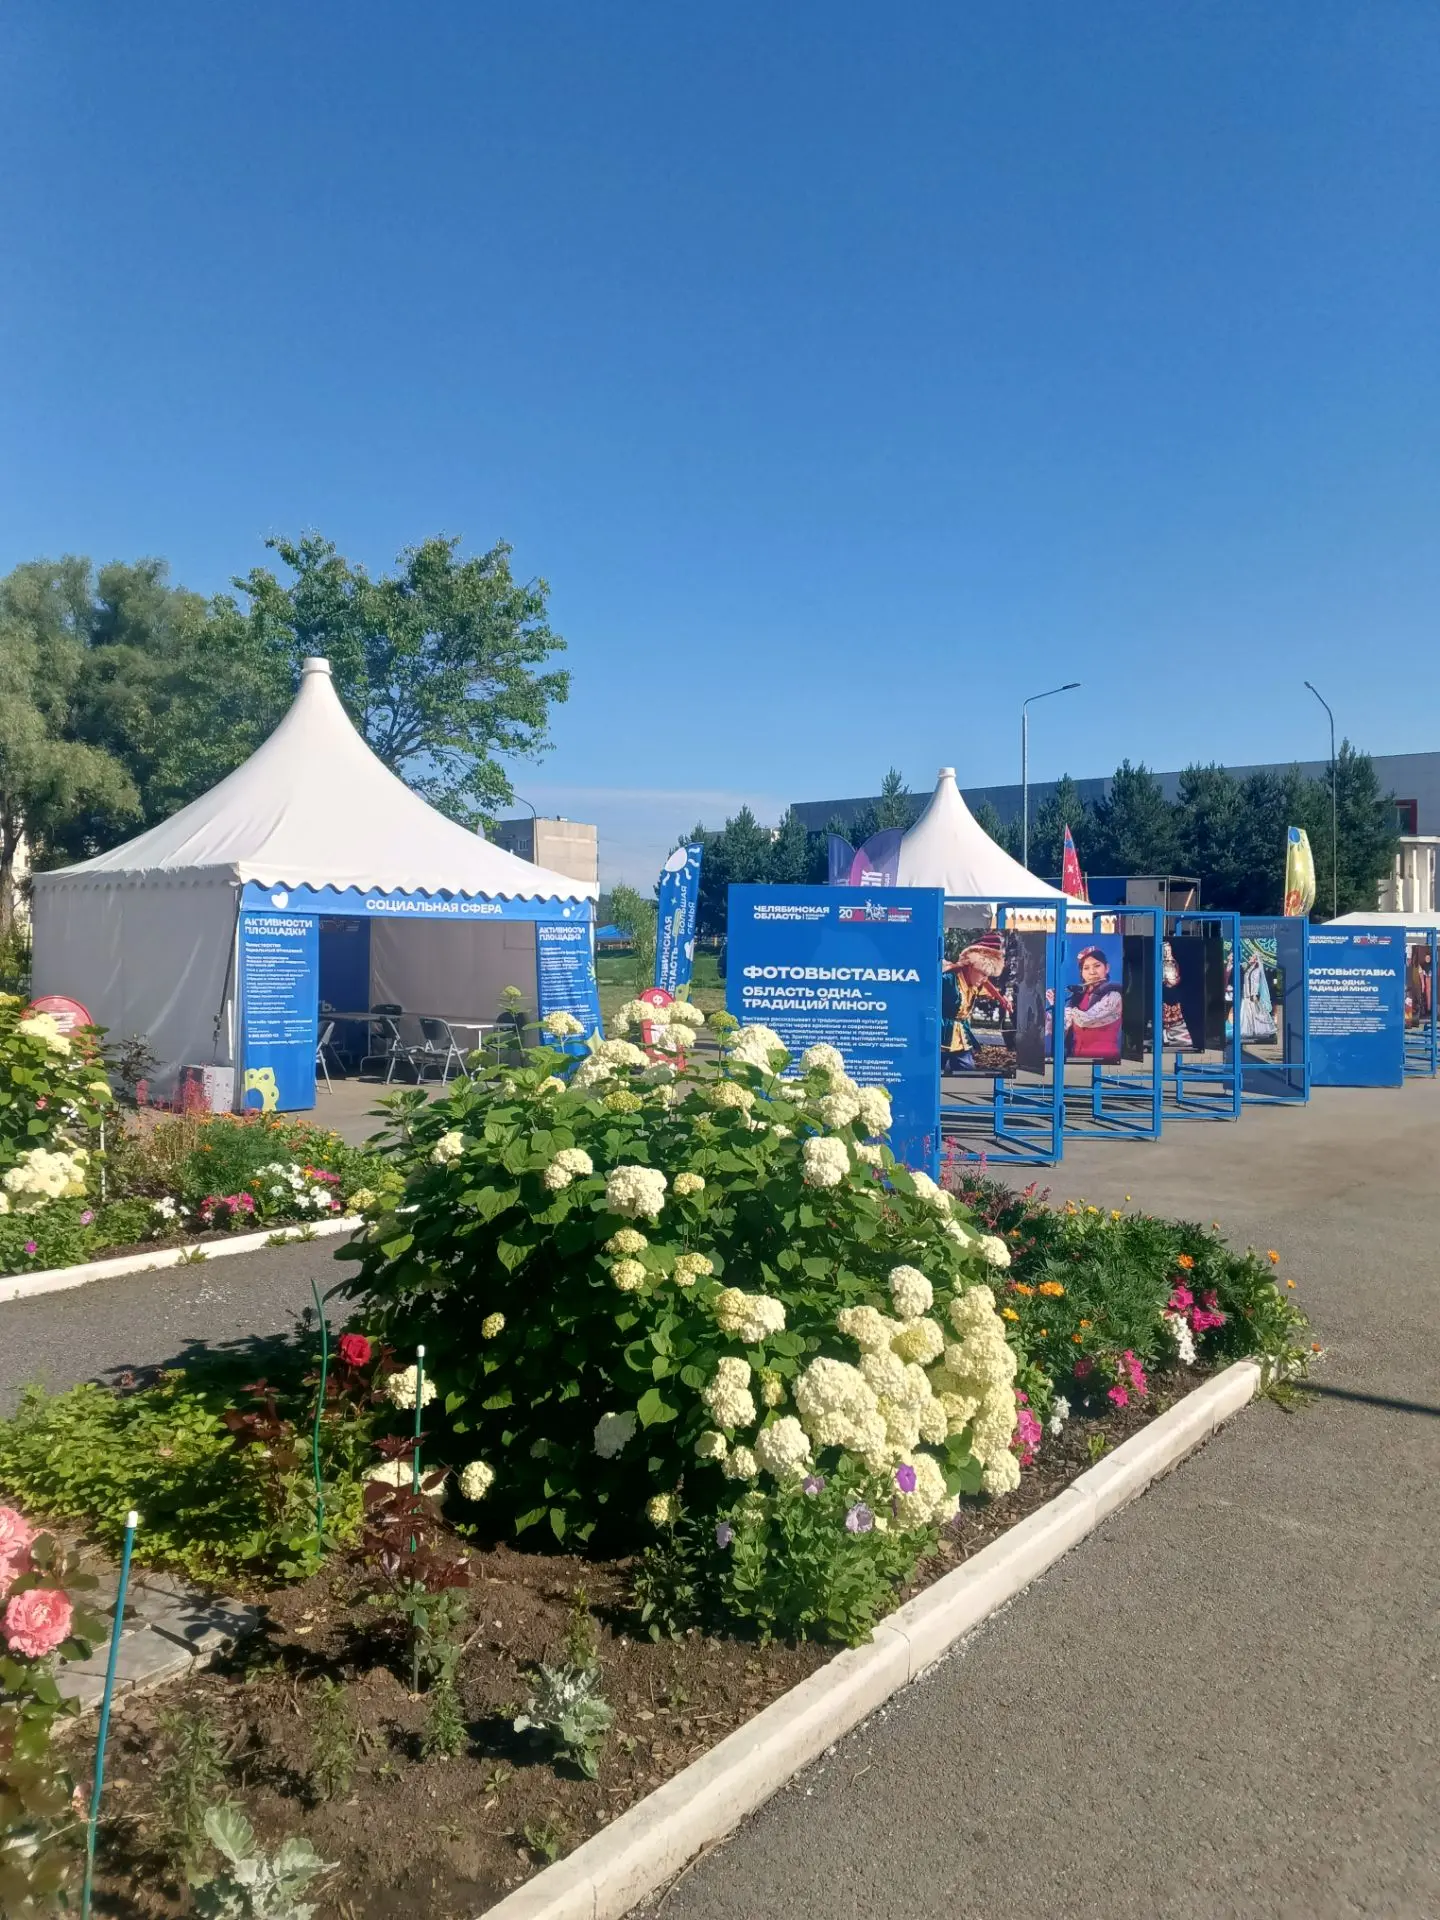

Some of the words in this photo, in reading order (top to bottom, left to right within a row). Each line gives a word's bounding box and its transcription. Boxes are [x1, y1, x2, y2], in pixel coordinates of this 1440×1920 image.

[366, 899, 458, 912] СОЦИАЛЬНАЯ
[461, 902, 503, 914] СФЕРА
[678, 885, 688, 935] БОЛЬШАЯ
[753, 905, 830, 914] ЧЕЛЯБИНСКАЯ
[244, 917, 313, 928] АКТИВНОСТИ
[245, 926, 306, 936] ПЛОЩАДКИ
[659, 915, 673, 989] ЕЛЯБИНСКАЯ
[743, 965, 920, 982] ФОТОВЫСТАВКА
[1309, 978, 1341, 986] БЛАСТЬ
[742, 986, 815, 998] ОБЛАСТЬ
[817, 987, 863, 999] ОДНА
[742, 998, 830, 1011] ТРАДИЦИЙ
[832, 1000, 887, 1012] МНОГО
